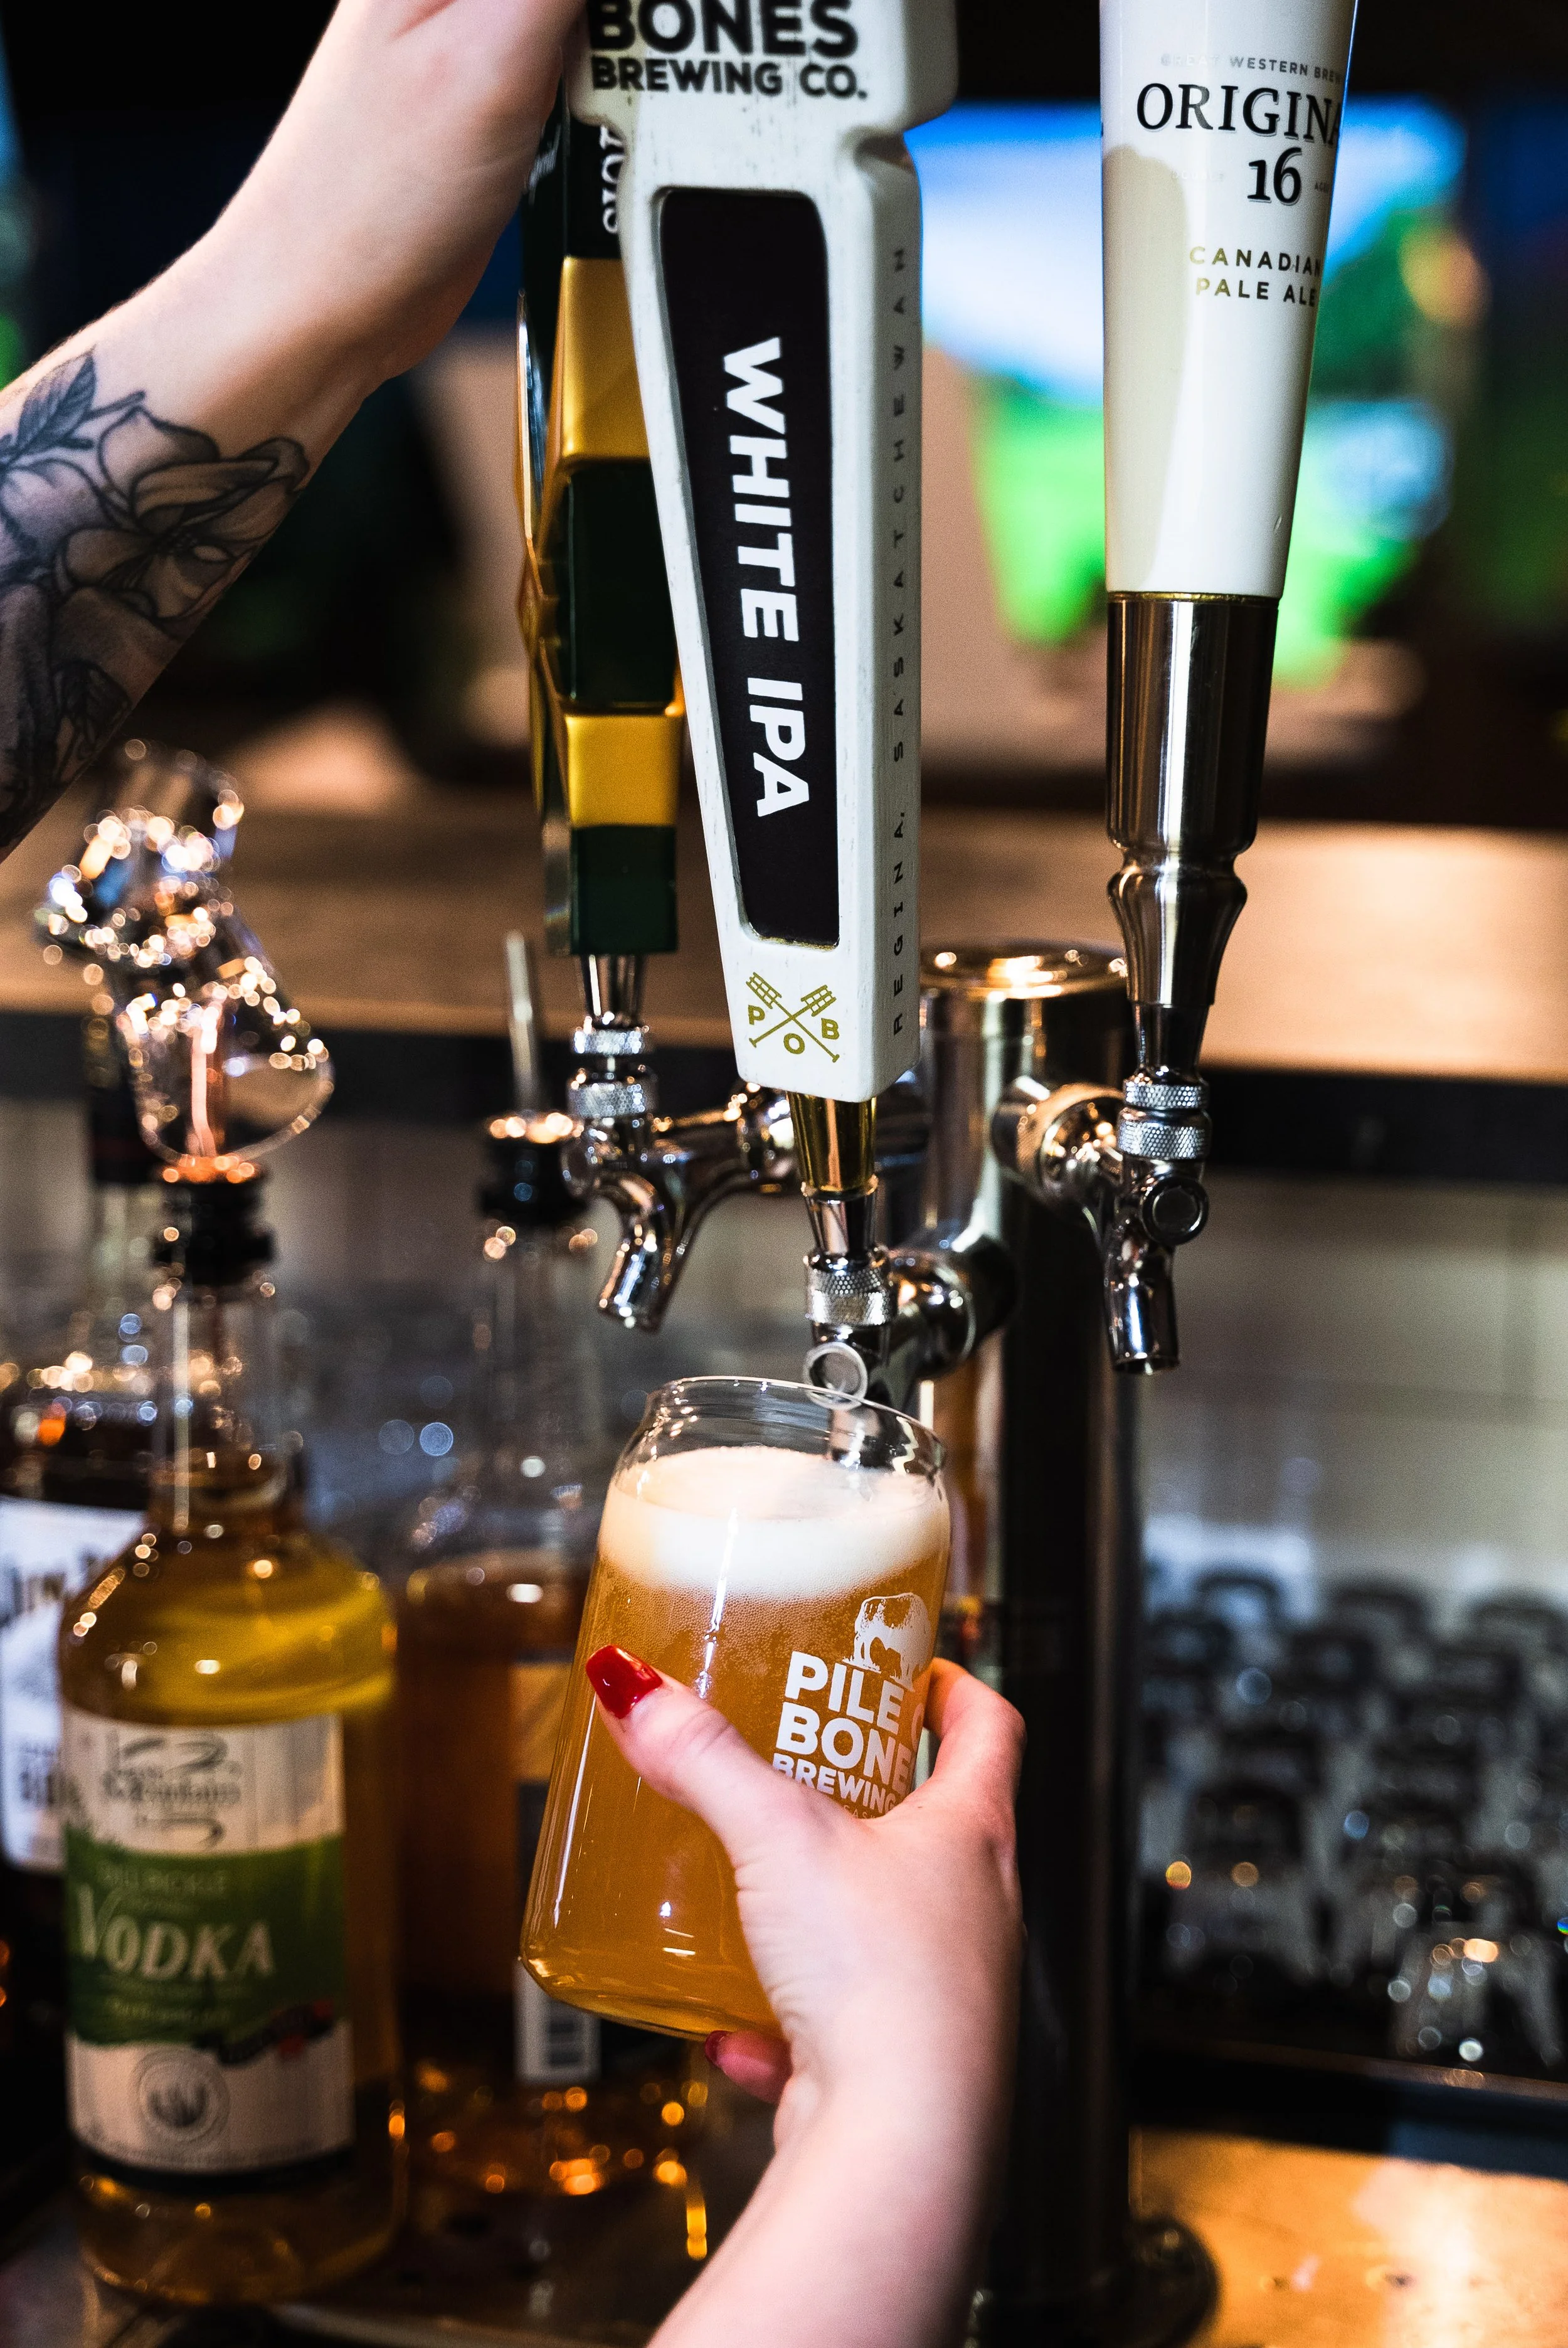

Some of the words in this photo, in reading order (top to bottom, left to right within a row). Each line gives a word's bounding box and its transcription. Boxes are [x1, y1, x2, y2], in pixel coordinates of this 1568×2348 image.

[587, 0, 859, 58] BONES
[591, 56, 783, 97] BREWING
[799, 65, 867, 99] CO.
[1230, 57, 1308, 76] WESTERN
[1248, 147, 1303, 206] 16
[1195, 277, 1269, 300] PALE
[1283, 284, 1316, 307] ALE
[723, 336, 799, 642] WHITE
[892, 248, 905, 763] SASKATCHEWAN
[747, 677, 810, 817] IPA
[785, 1650, 904, 1735] PILE
[773, 1753, 896, 1814] BREWING
[776, 1702, 916, 1795] BONE
[77, 1882, 275, 1980] VODKA
